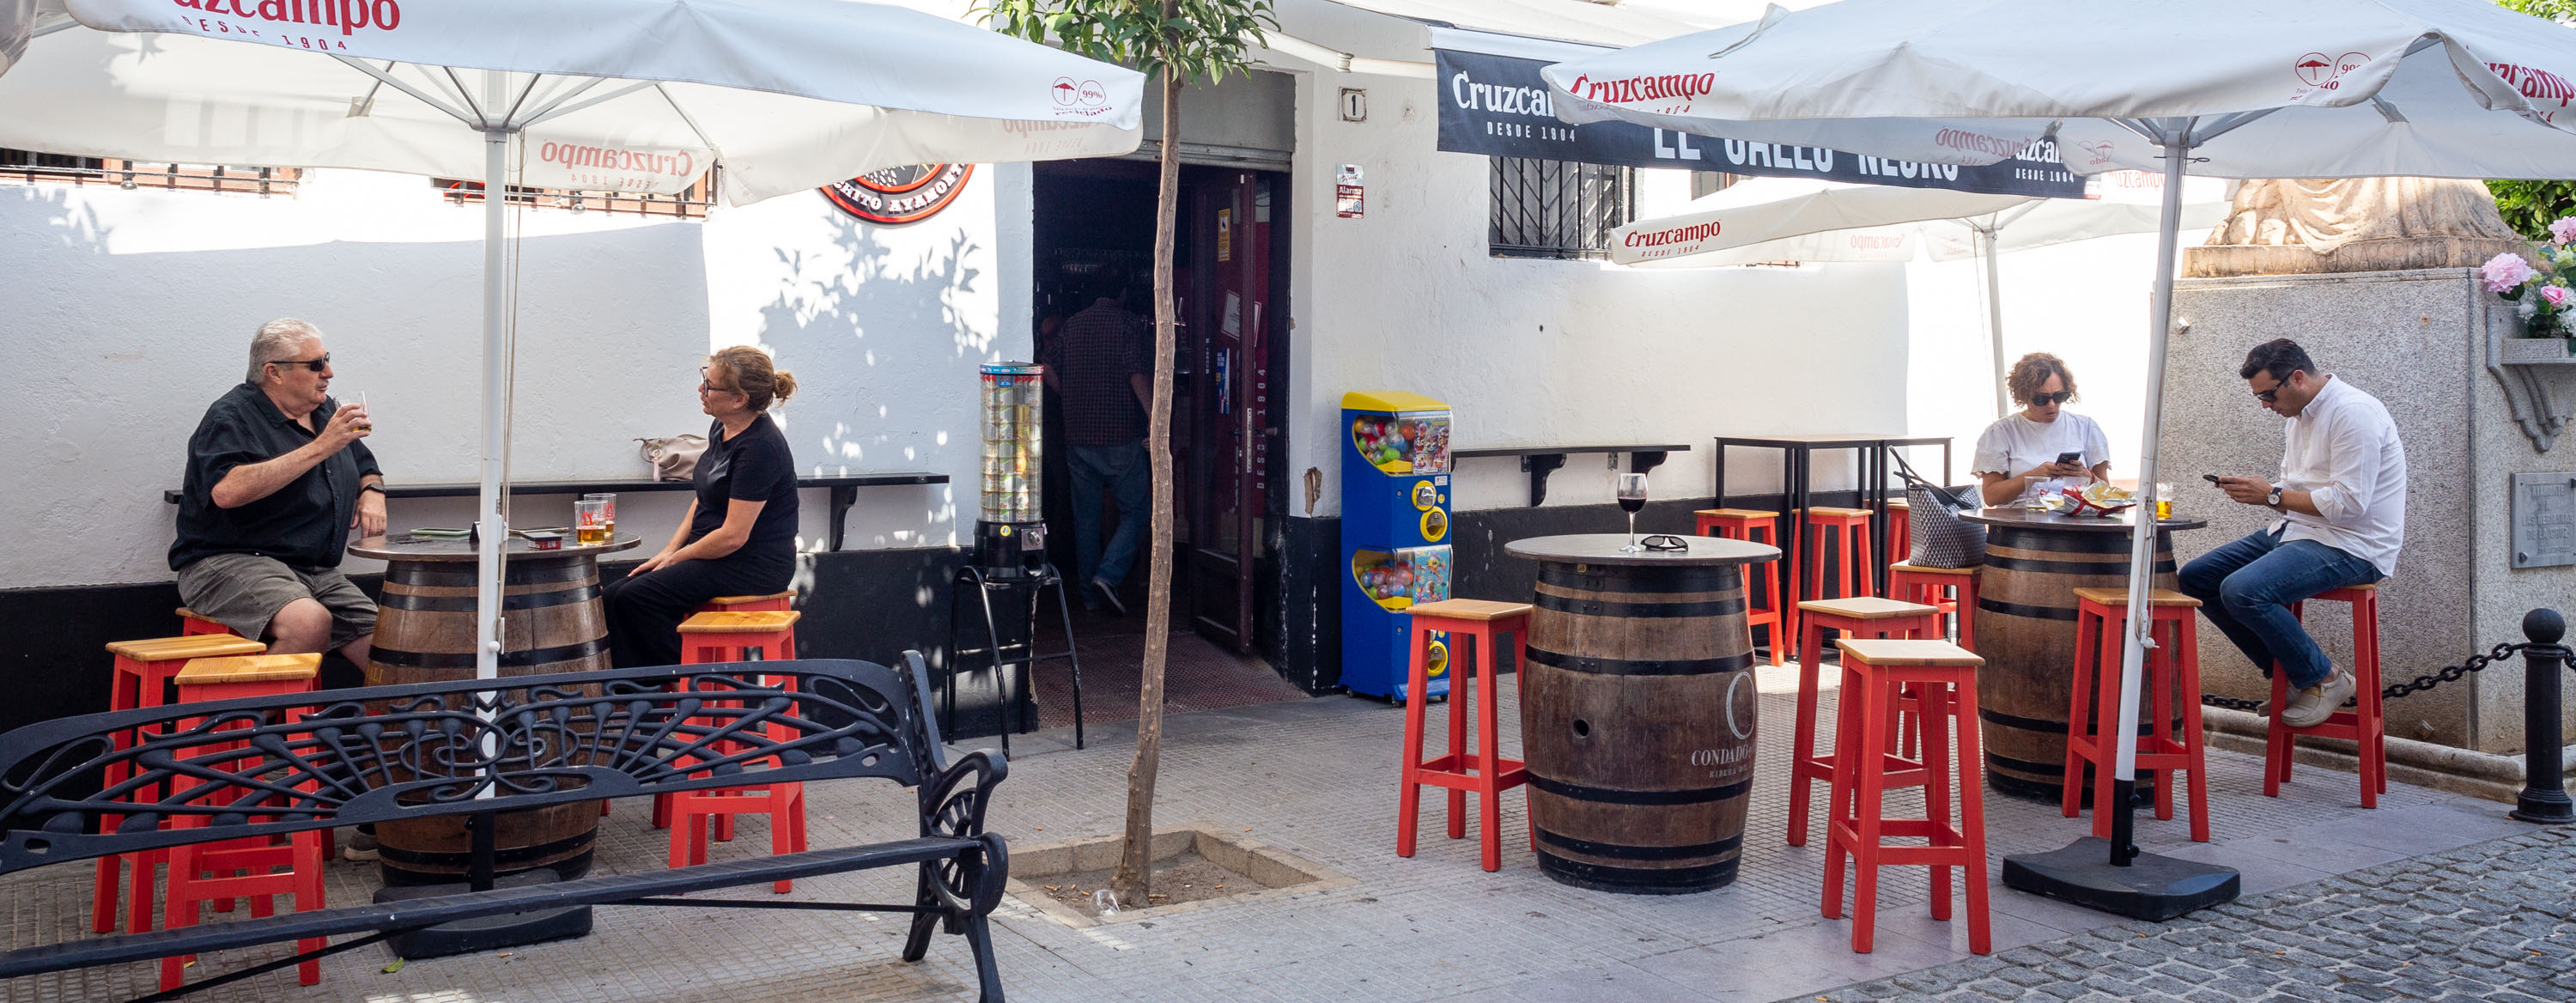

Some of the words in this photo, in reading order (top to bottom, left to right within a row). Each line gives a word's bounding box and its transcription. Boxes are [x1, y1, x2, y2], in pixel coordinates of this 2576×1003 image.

[1082, 89, 1103, 99] 99%
[1351, 94, 1357, 116] 1
[1486, 120, 1531, 139] DESDE
[1541, 125, 1577, 143] 1904
[2015, 167, 2044, 180] DESDE
[888, 162, 965, 214] AYAMONT
[1625, 221, 1721, 247] Cruzcampo
